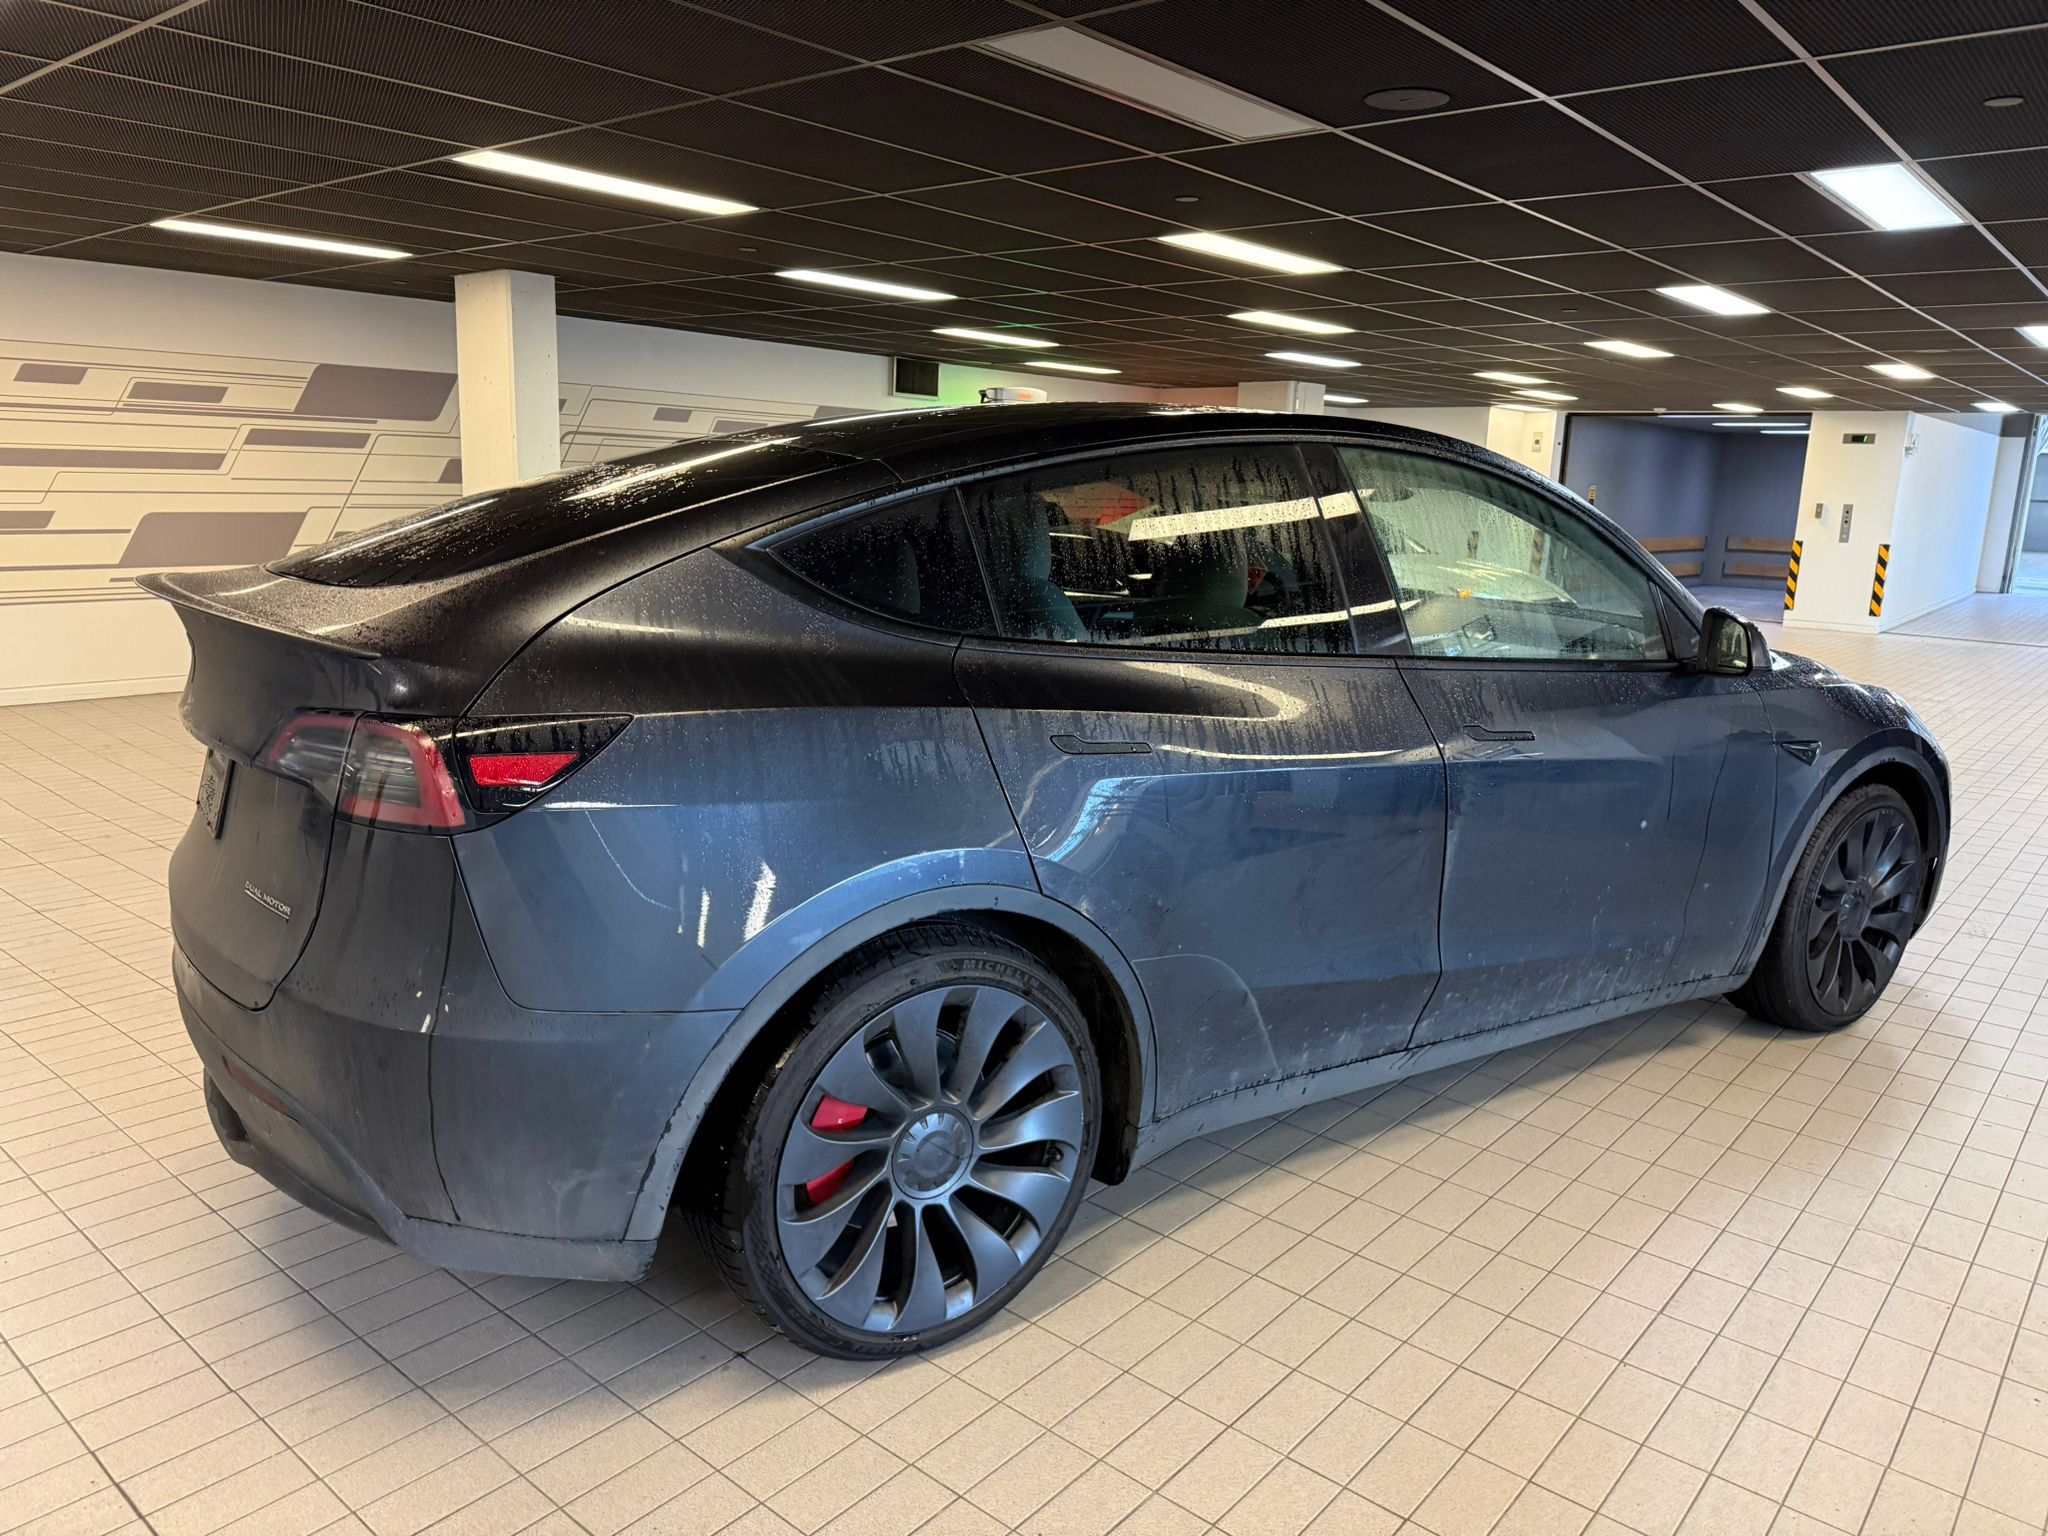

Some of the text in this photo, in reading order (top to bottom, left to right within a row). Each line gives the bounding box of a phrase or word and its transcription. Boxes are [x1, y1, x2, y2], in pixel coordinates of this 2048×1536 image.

[245, 880, 291, 915] DUAL MOTOR
[962, 959, 1040, 987] MICHELIN
